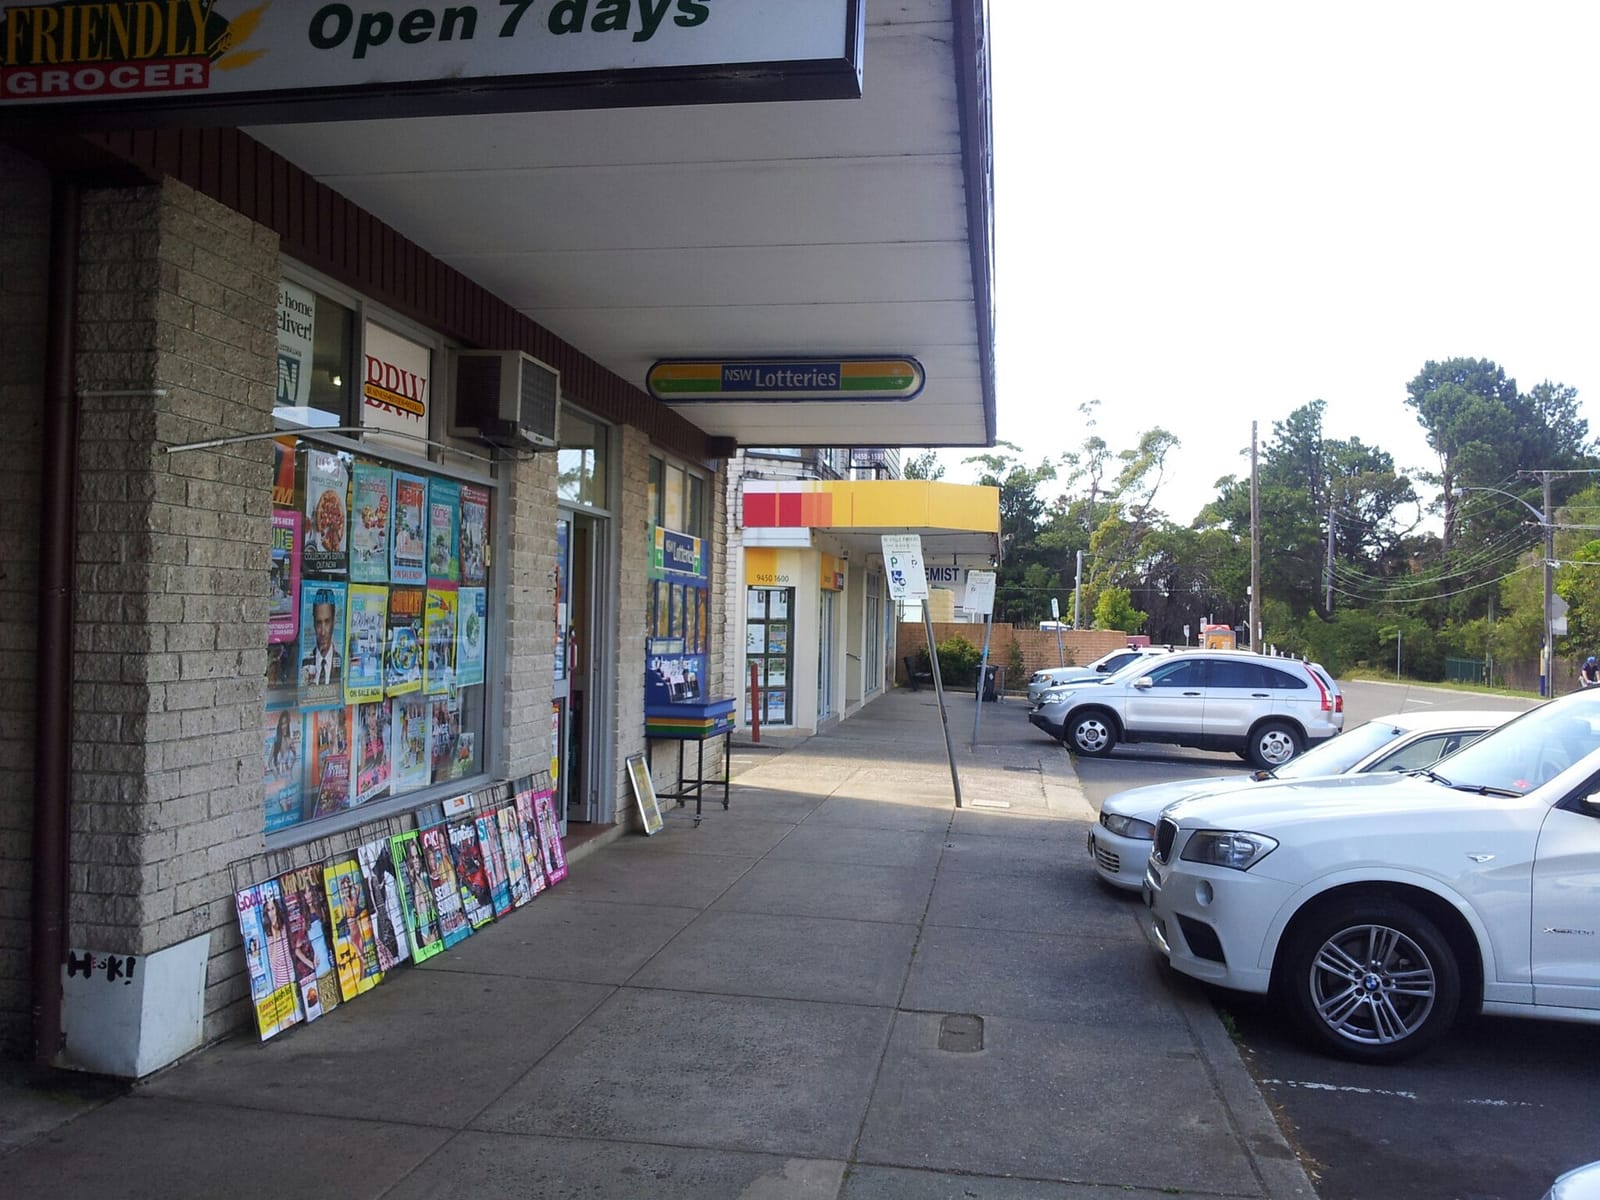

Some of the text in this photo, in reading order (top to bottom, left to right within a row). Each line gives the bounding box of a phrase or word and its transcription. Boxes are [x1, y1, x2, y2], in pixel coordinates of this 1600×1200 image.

[5, 0, 214, 65] FRIENDLY
[308, 0, 711, 59] Open 7 days
[6, 62, 206, 95] GROCER
[285, 291, 313, 318] home
[277, 310, 313, 342] eliver!
[725, 369, 837, 388] NSW Lotteries
[756, 573, 789, 583] 9450 1600
[924, 567, 960, 582] EMIST
